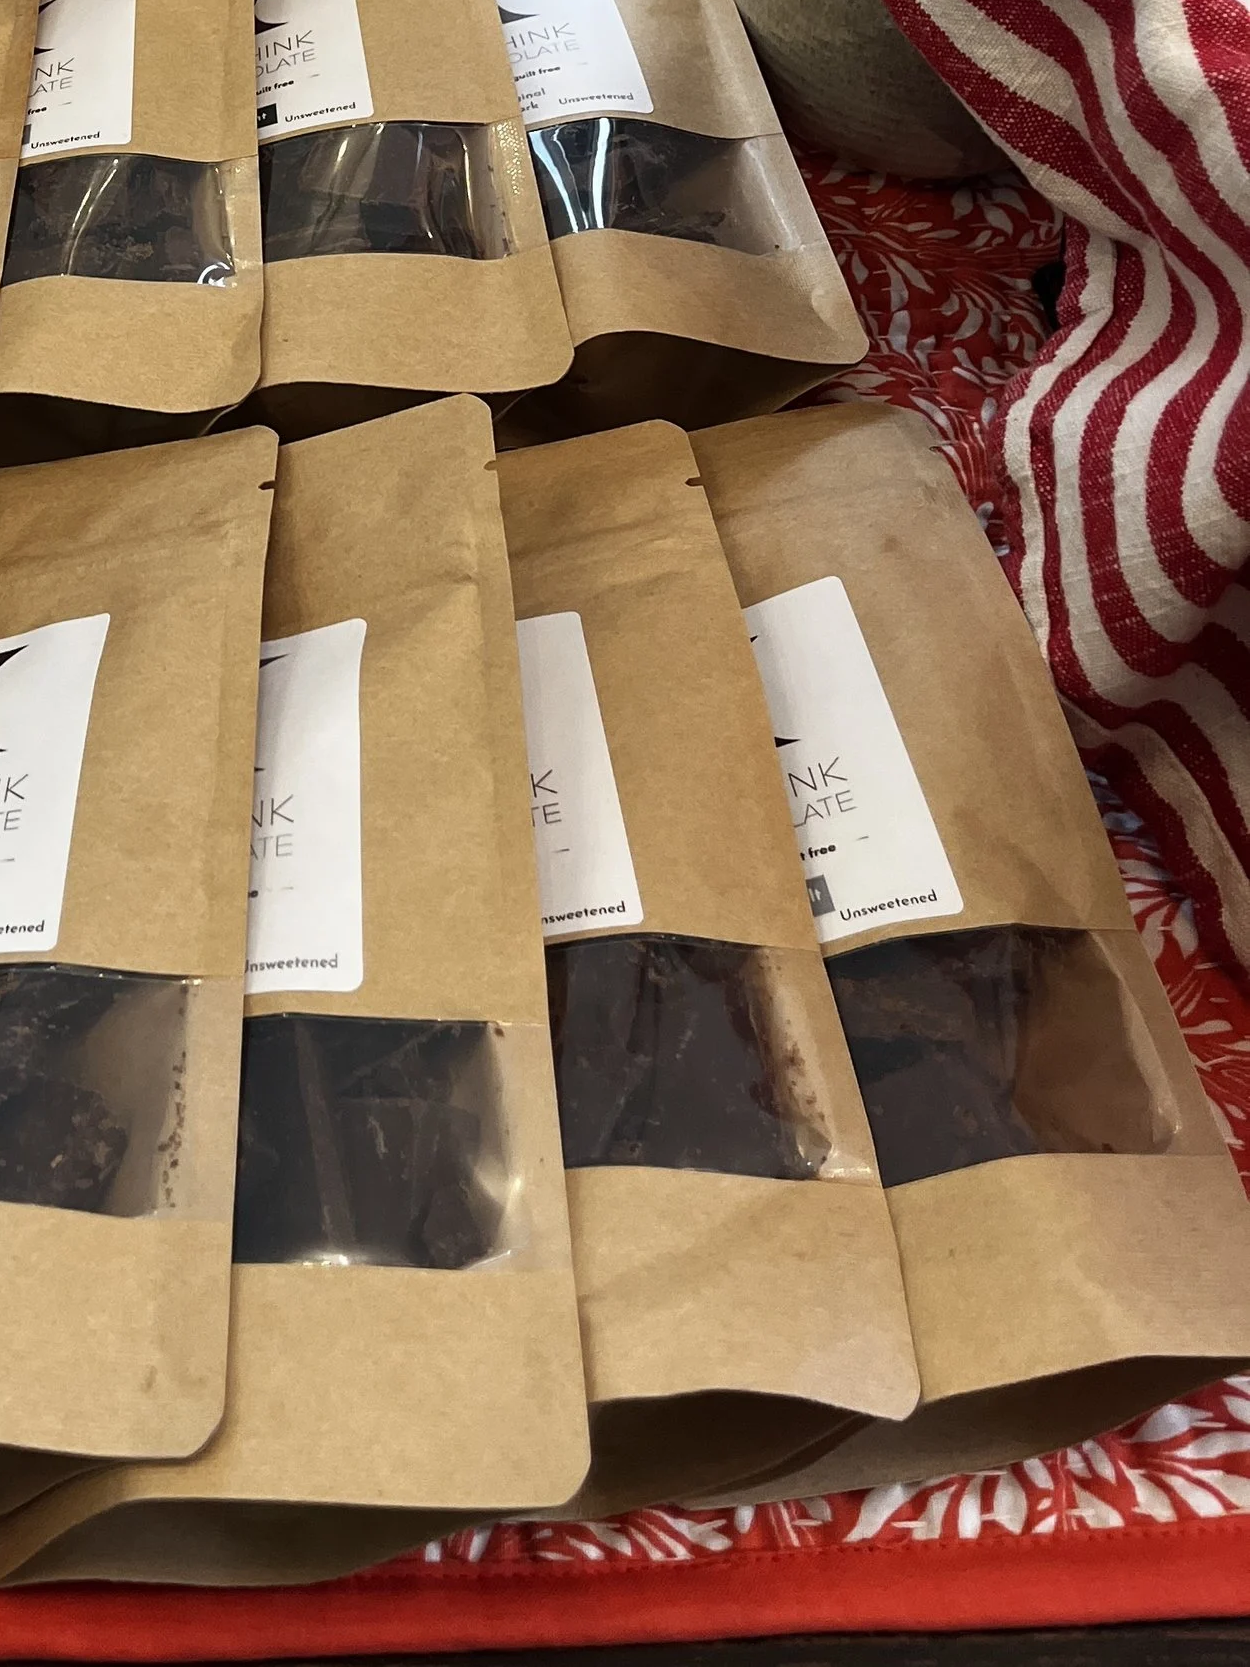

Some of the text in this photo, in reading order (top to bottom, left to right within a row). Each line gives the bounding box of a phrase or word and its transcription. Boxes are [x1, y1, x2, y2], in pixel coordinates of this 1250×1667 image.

[505, 22, 576, 48] HINK
[255, 30, 315, 61] HINK
[509, 39, 580, 63] OLATE
[255, 48, 316, 78] OLATE
[539, 66, 561, 74] free
[256, 80, 295, 96] uilt free
[558, 93, 634, 105] Unsweetened
[27, 106, 47, 115] free
[285, 102, 356, 122] Unsweetened
[31, 131, 101, 149] Unsweetened
[808, 844, 837, 859] free
[541, 900, 626, 925] nsweetened
[839, 890, 938, 921] Unsweetened
